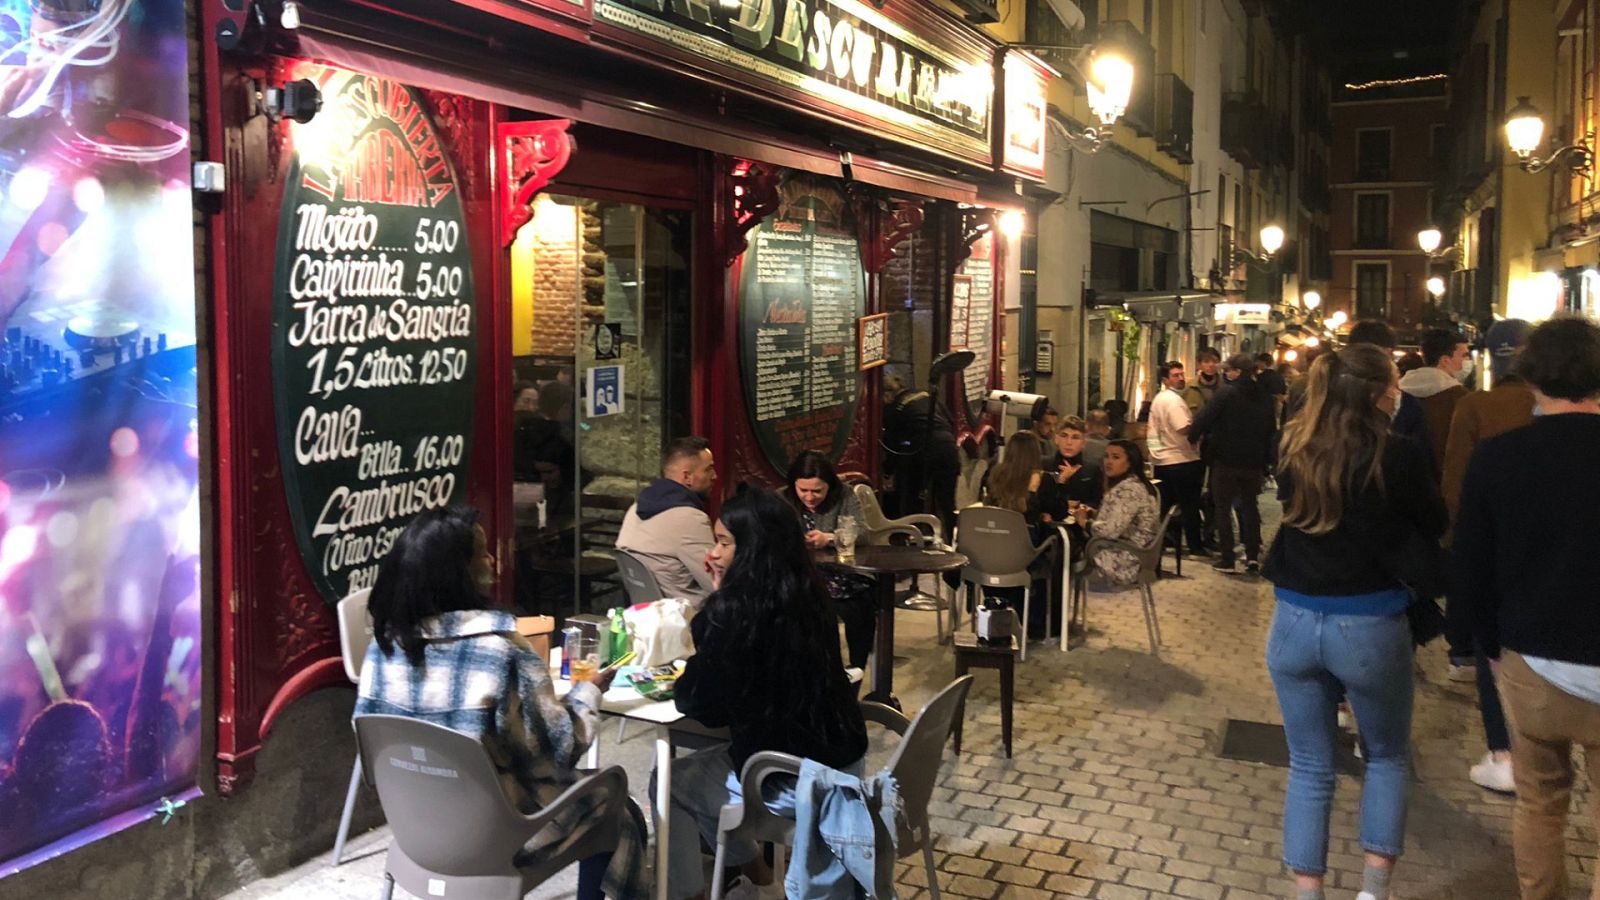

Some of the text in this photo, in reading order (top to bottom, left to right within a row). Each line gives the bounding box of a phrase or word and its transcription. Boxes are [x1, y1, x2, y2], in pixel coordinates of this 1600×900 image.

[338, 76, 454, 208] SCUBIERTA
[288, 300, 367, 347] Jarra
[367, 304, 387, 339] de
[306, 347, 358, 399] 1,5
[312, 472, 455, 538] Lambrusco
